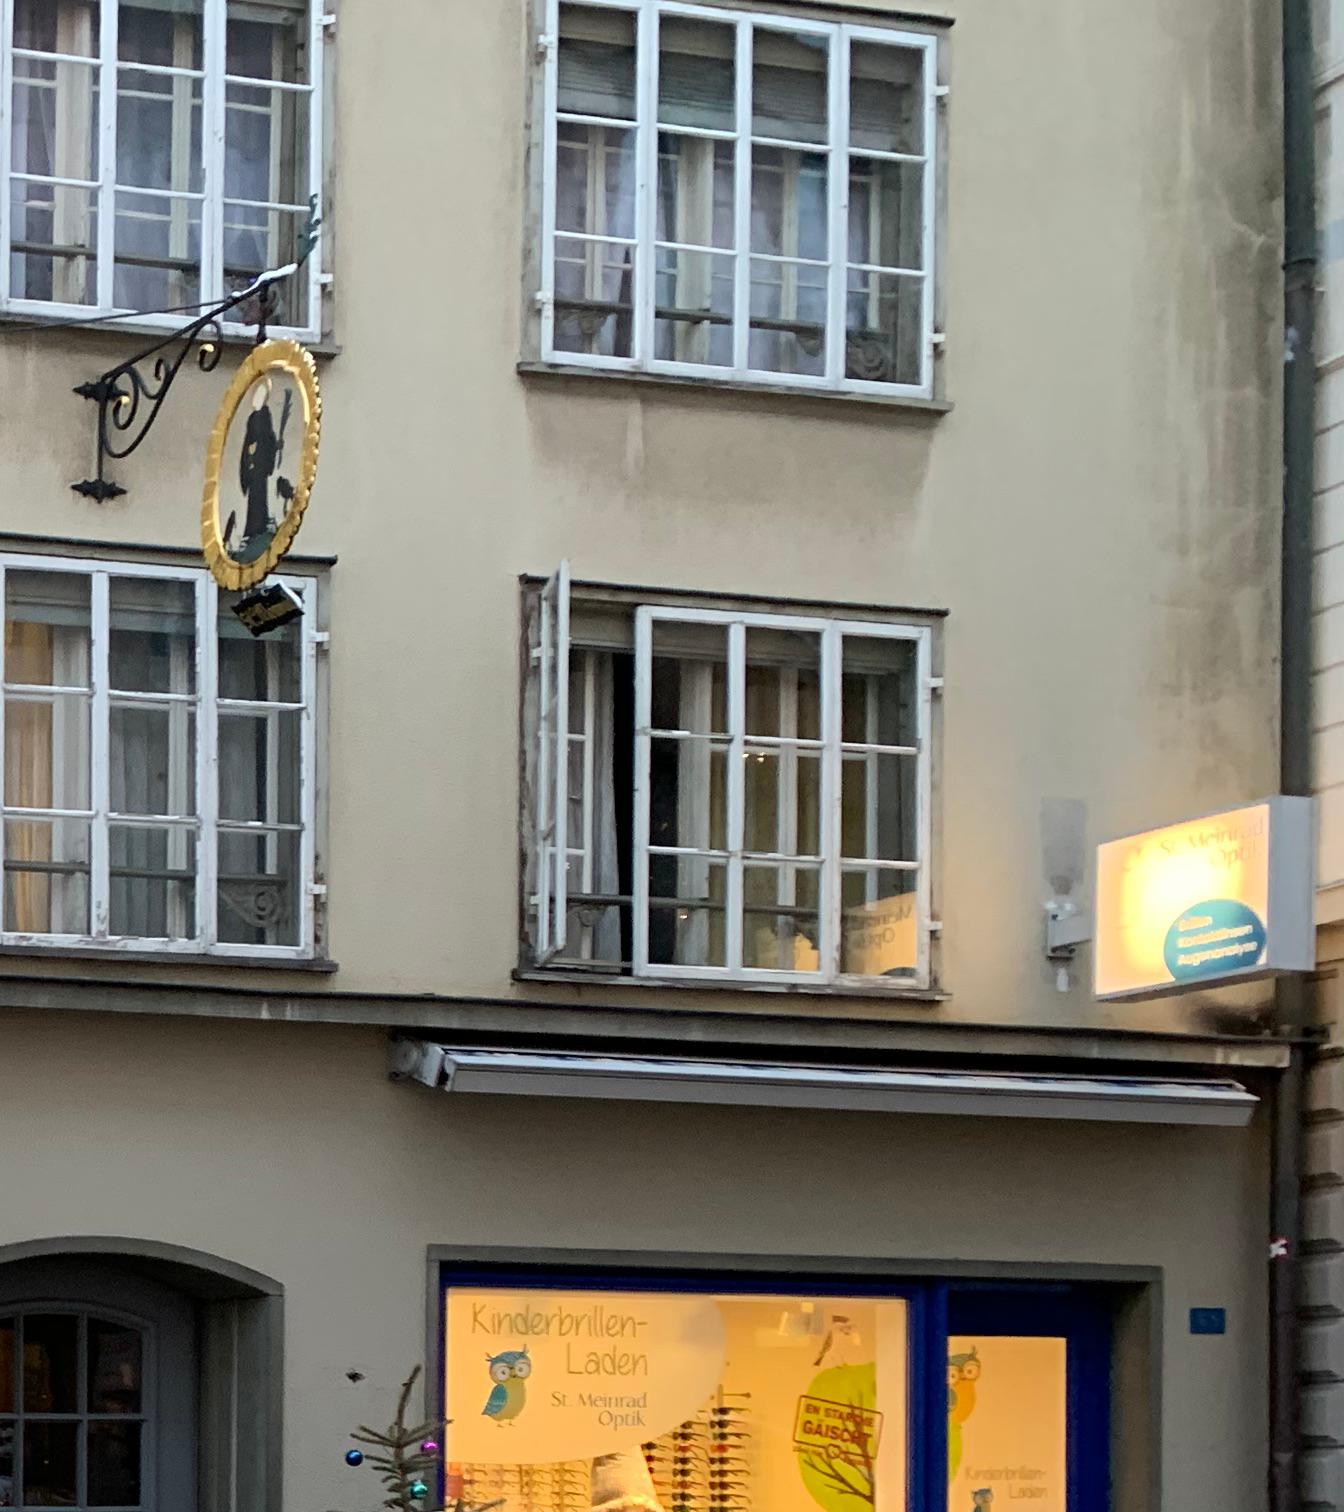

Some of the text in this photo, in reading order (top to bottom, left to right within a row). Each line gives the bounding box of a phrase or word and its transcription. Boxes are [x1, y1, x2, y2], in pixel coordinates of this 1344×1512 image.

[470, 1301, 648, 1338] Kinderbrillen-
[565, 1342, 648, 1376] Laden
[577, 1392, 648, 1410] Meinrad
[805, 1403, 821, 1415] EN
[598, 1409, 647, 1432] Optik
